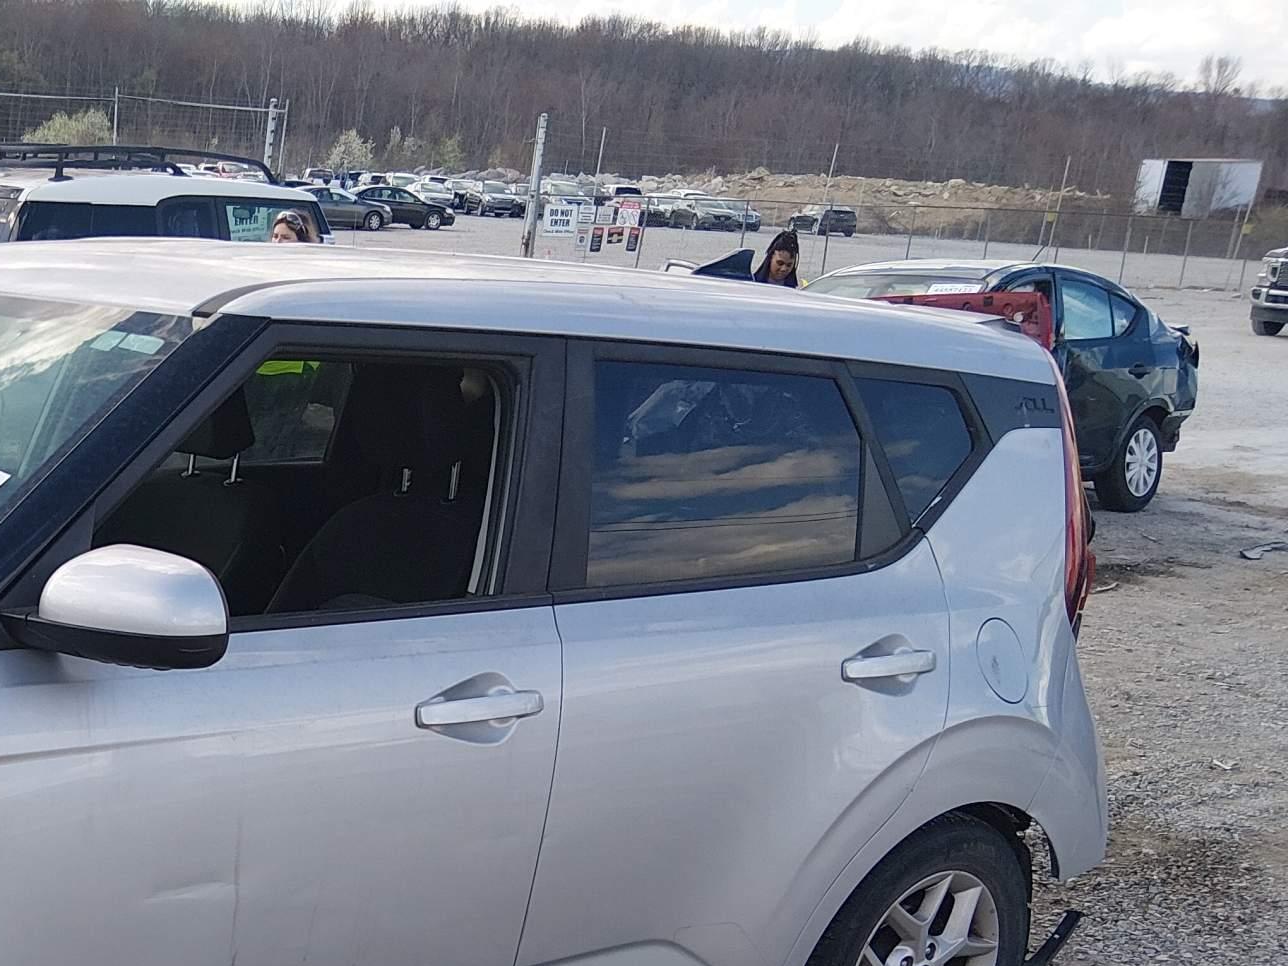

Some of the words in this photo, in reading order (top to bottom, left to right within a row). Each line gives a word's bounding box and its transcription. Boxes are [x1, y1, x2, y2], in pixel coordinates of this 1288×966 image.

[549, 208, 559, 217] DO
[560, 208, 573, 218] NOT
[550, 218, 570, 227] ENTER
